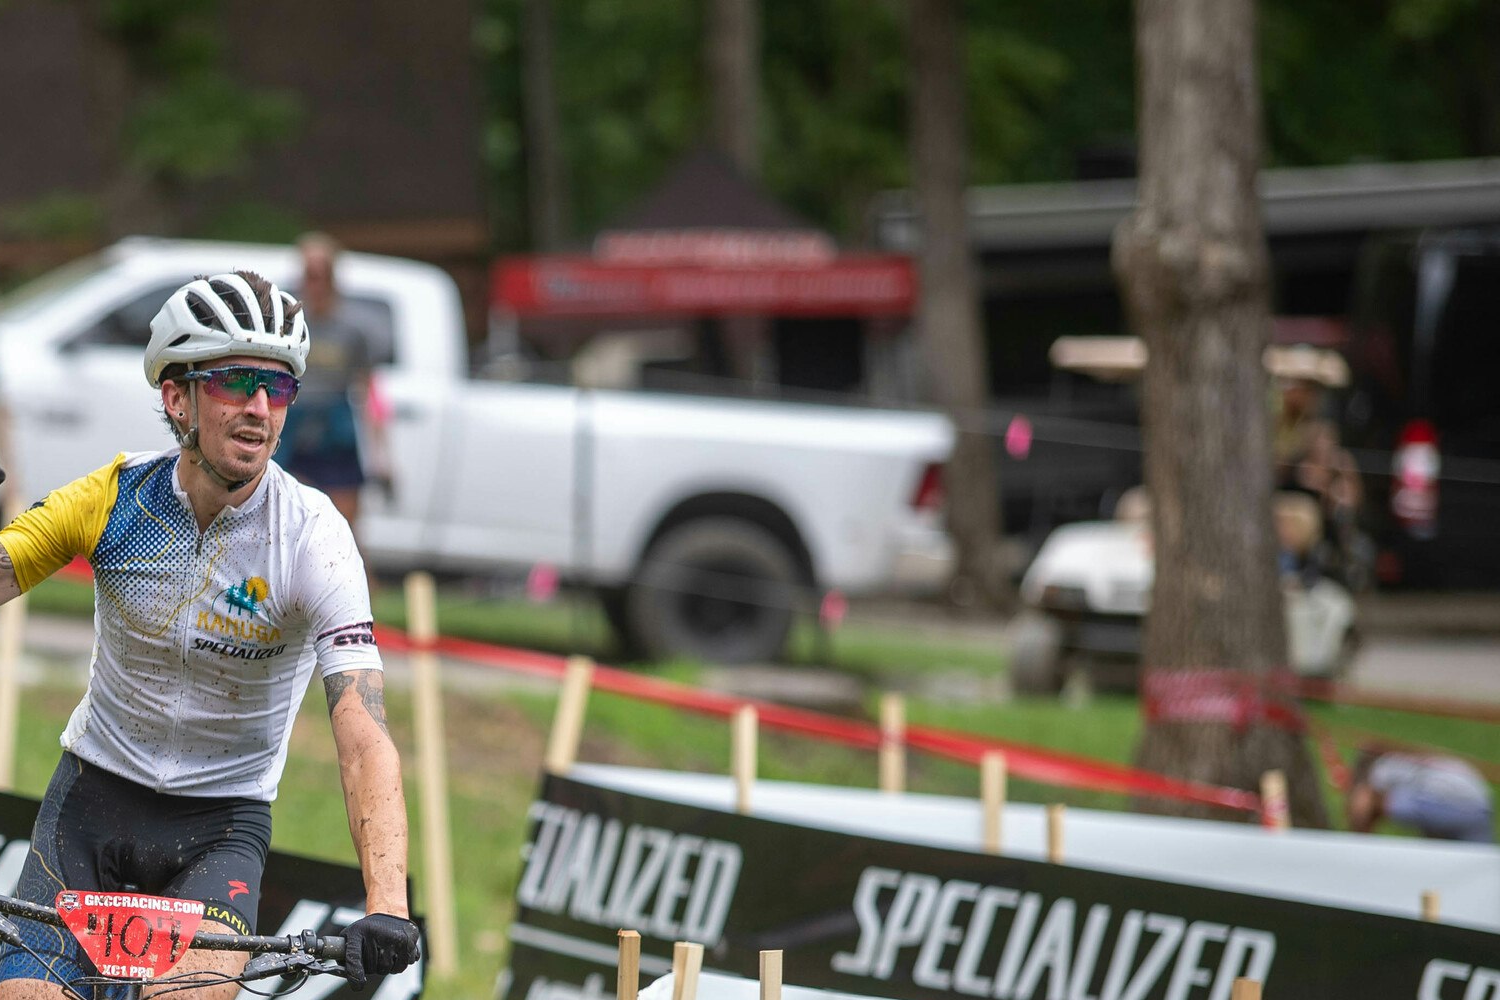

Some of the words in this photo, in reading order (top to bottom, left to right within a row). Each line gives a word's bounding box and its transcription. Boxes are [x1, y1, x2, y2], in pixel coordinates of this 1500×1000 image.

[190, 637, 288, 660] SPECIALIZED
[84, 893, 204, 915] GNCCRACING.COM
[102, 964, 127, 977] XC1
[130, 965, 155, 978] PRO
